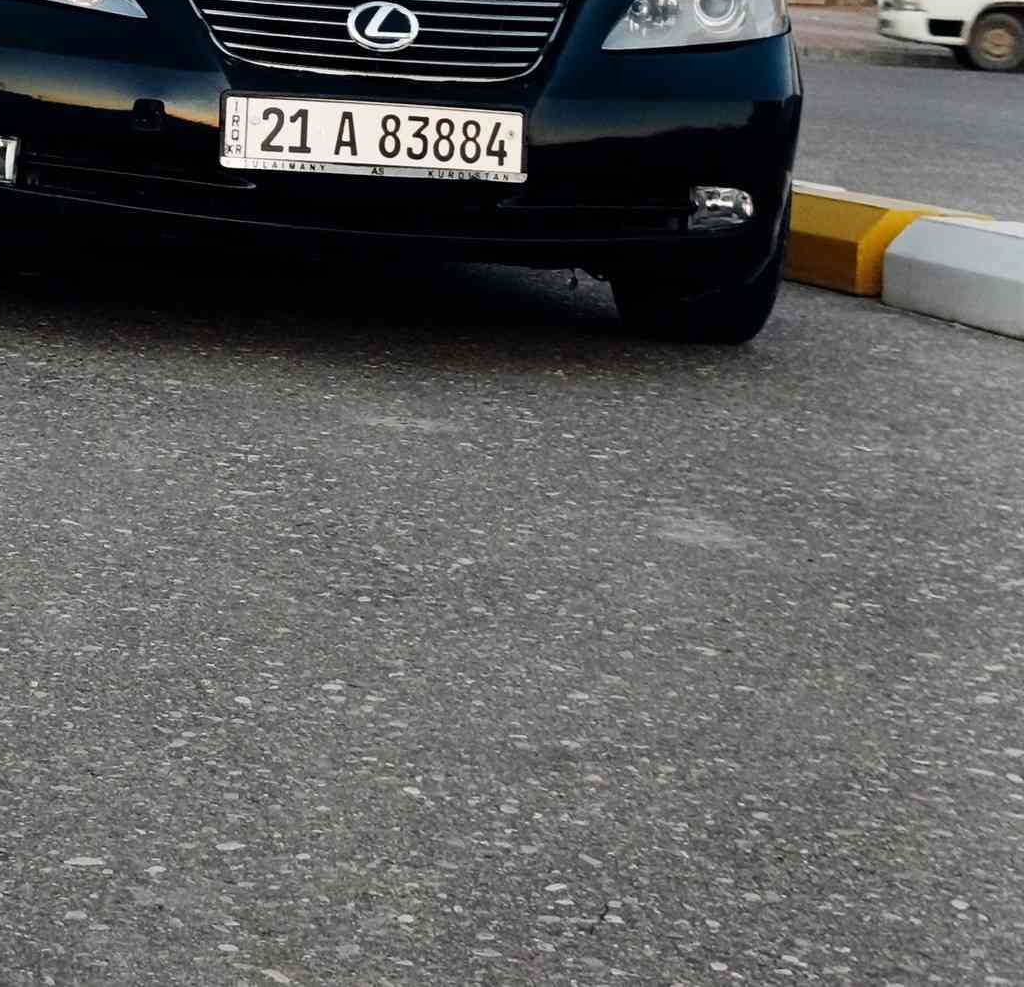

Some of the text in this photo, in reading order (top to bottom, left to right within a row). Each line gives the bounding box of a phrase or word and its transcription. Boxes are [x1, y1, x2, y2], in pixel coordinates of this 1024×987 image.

[261, 107, 508, 166] 21 A 83884
[370, 167, 385, 175] AS
